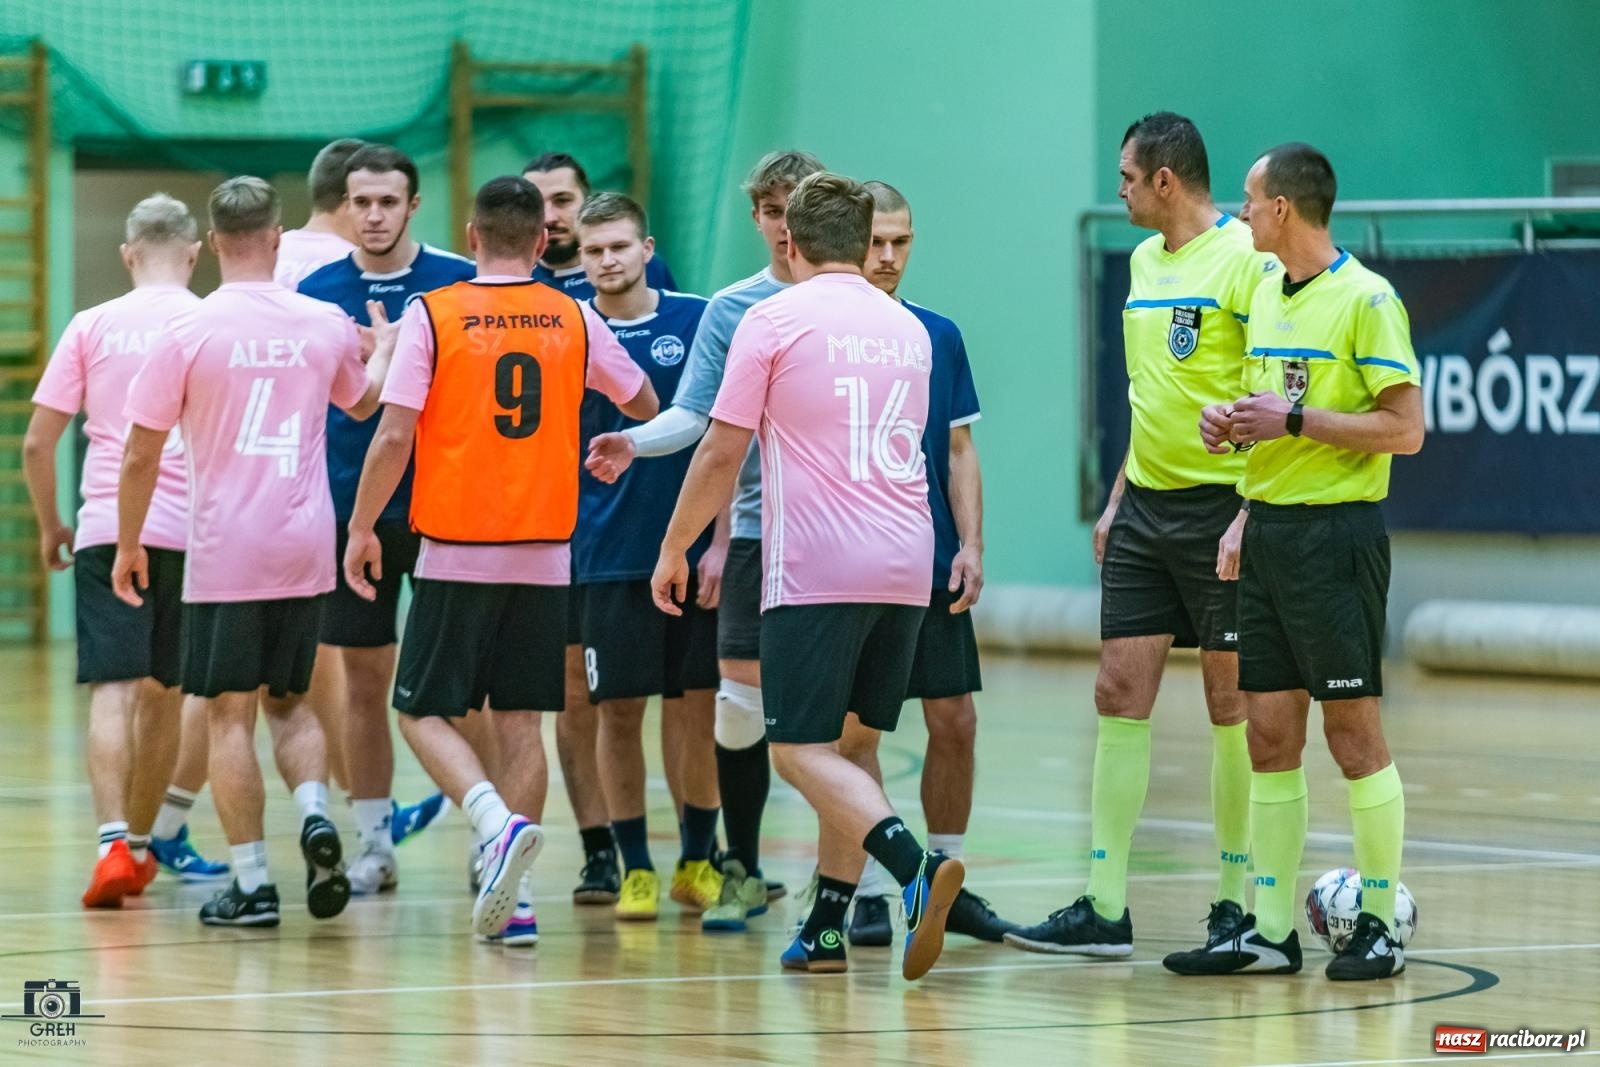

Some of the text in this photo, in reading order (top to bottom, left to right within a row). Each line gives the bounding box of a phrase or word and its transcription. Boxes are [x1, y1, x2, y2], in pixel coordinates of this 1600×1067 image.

[227, 338, 309, 368] ALEX
[484, 314, 564, 329] PATRICK
[233, 376, 301, 478] 4
[494, 351, 542, 440] 9
[1418, 326, 1600, 435] IBÓRZ
[834, 375, 925, 484] 16
